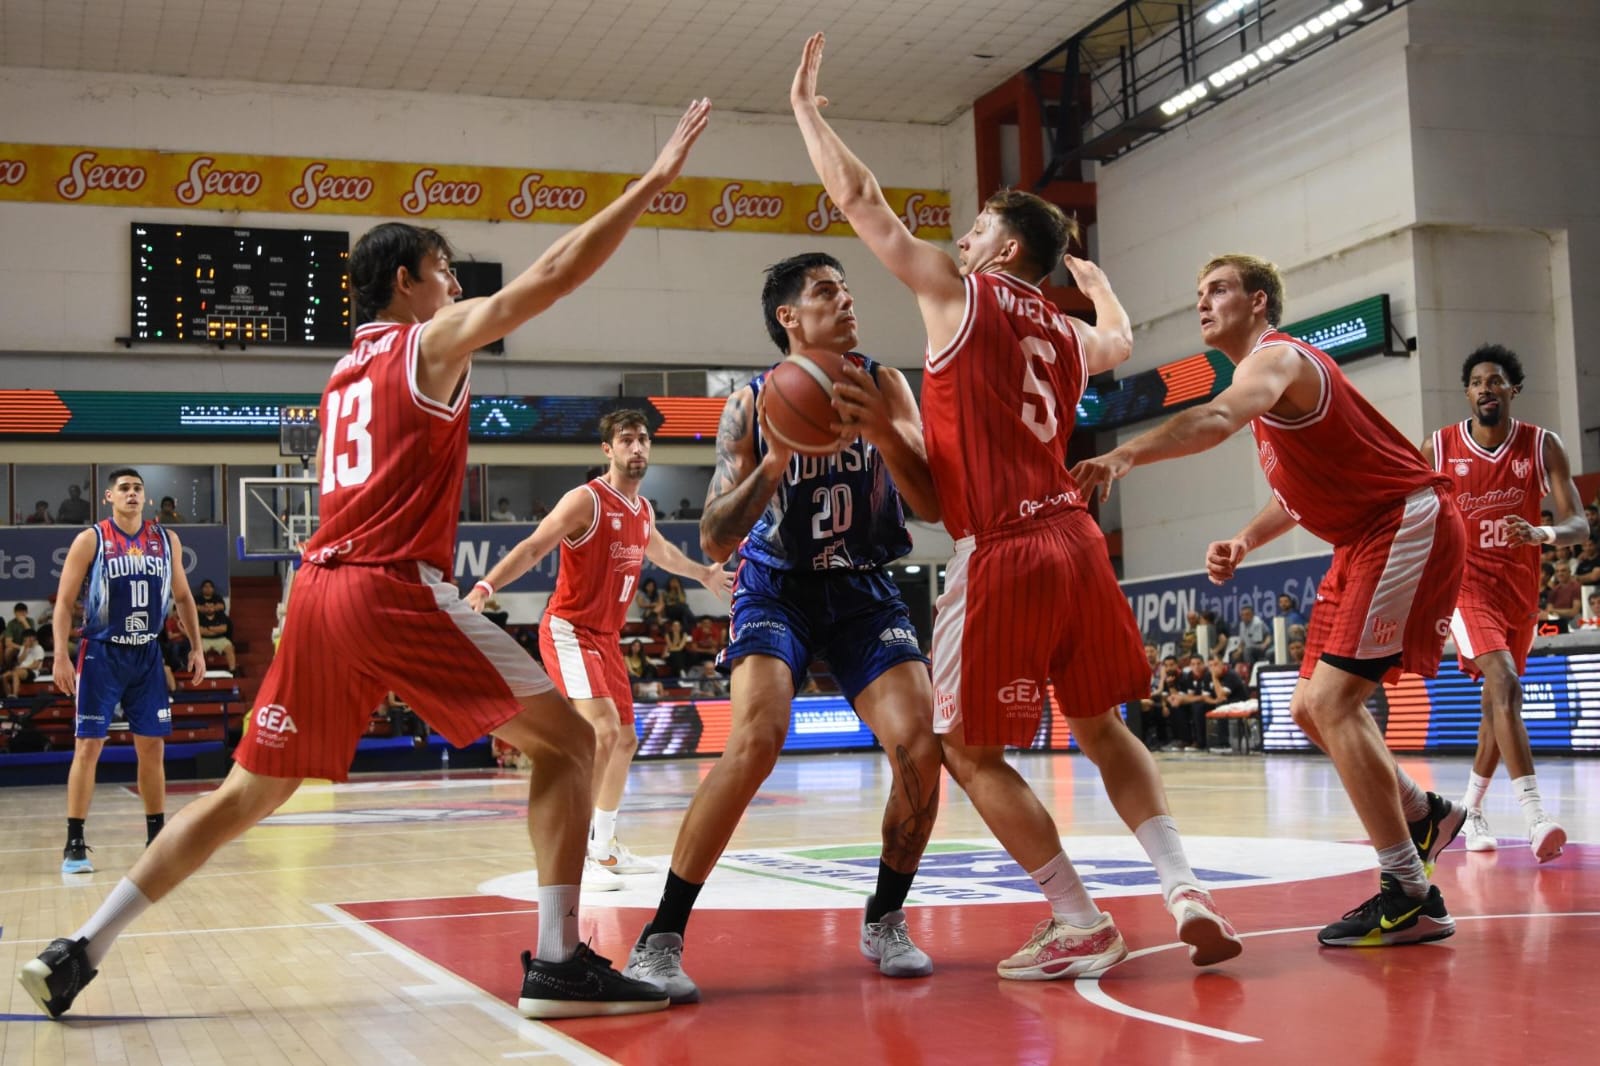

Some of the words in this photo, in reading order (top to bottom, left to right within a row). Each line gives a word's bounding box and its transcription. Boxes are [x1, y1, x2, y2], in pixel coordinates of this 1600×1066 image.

[58, 152, 147, 199] Secco
[176, 157, 262, 205] Secco
[290, 163, 374, 210] Secco
[401, 168, 482, 215] Secco
[509, 173, 587, 219] Secco
[622, 178, 688, 215] cco
[710, 183, 784, 228] Secco
[902, 194, 951, 235] Secc
[1018, 335, 1058, 443] 5
[321, 376, 373, 496] 13
[811, 483, 853, 540] 20
[1479, 519, 1508, 549] 20
[107, 555, 164, 579] QUIMSA
[129, 580, 149, 608] 10
[998, 684, 1041, 704] GEA
[256, 704, 298, 734] GEA
